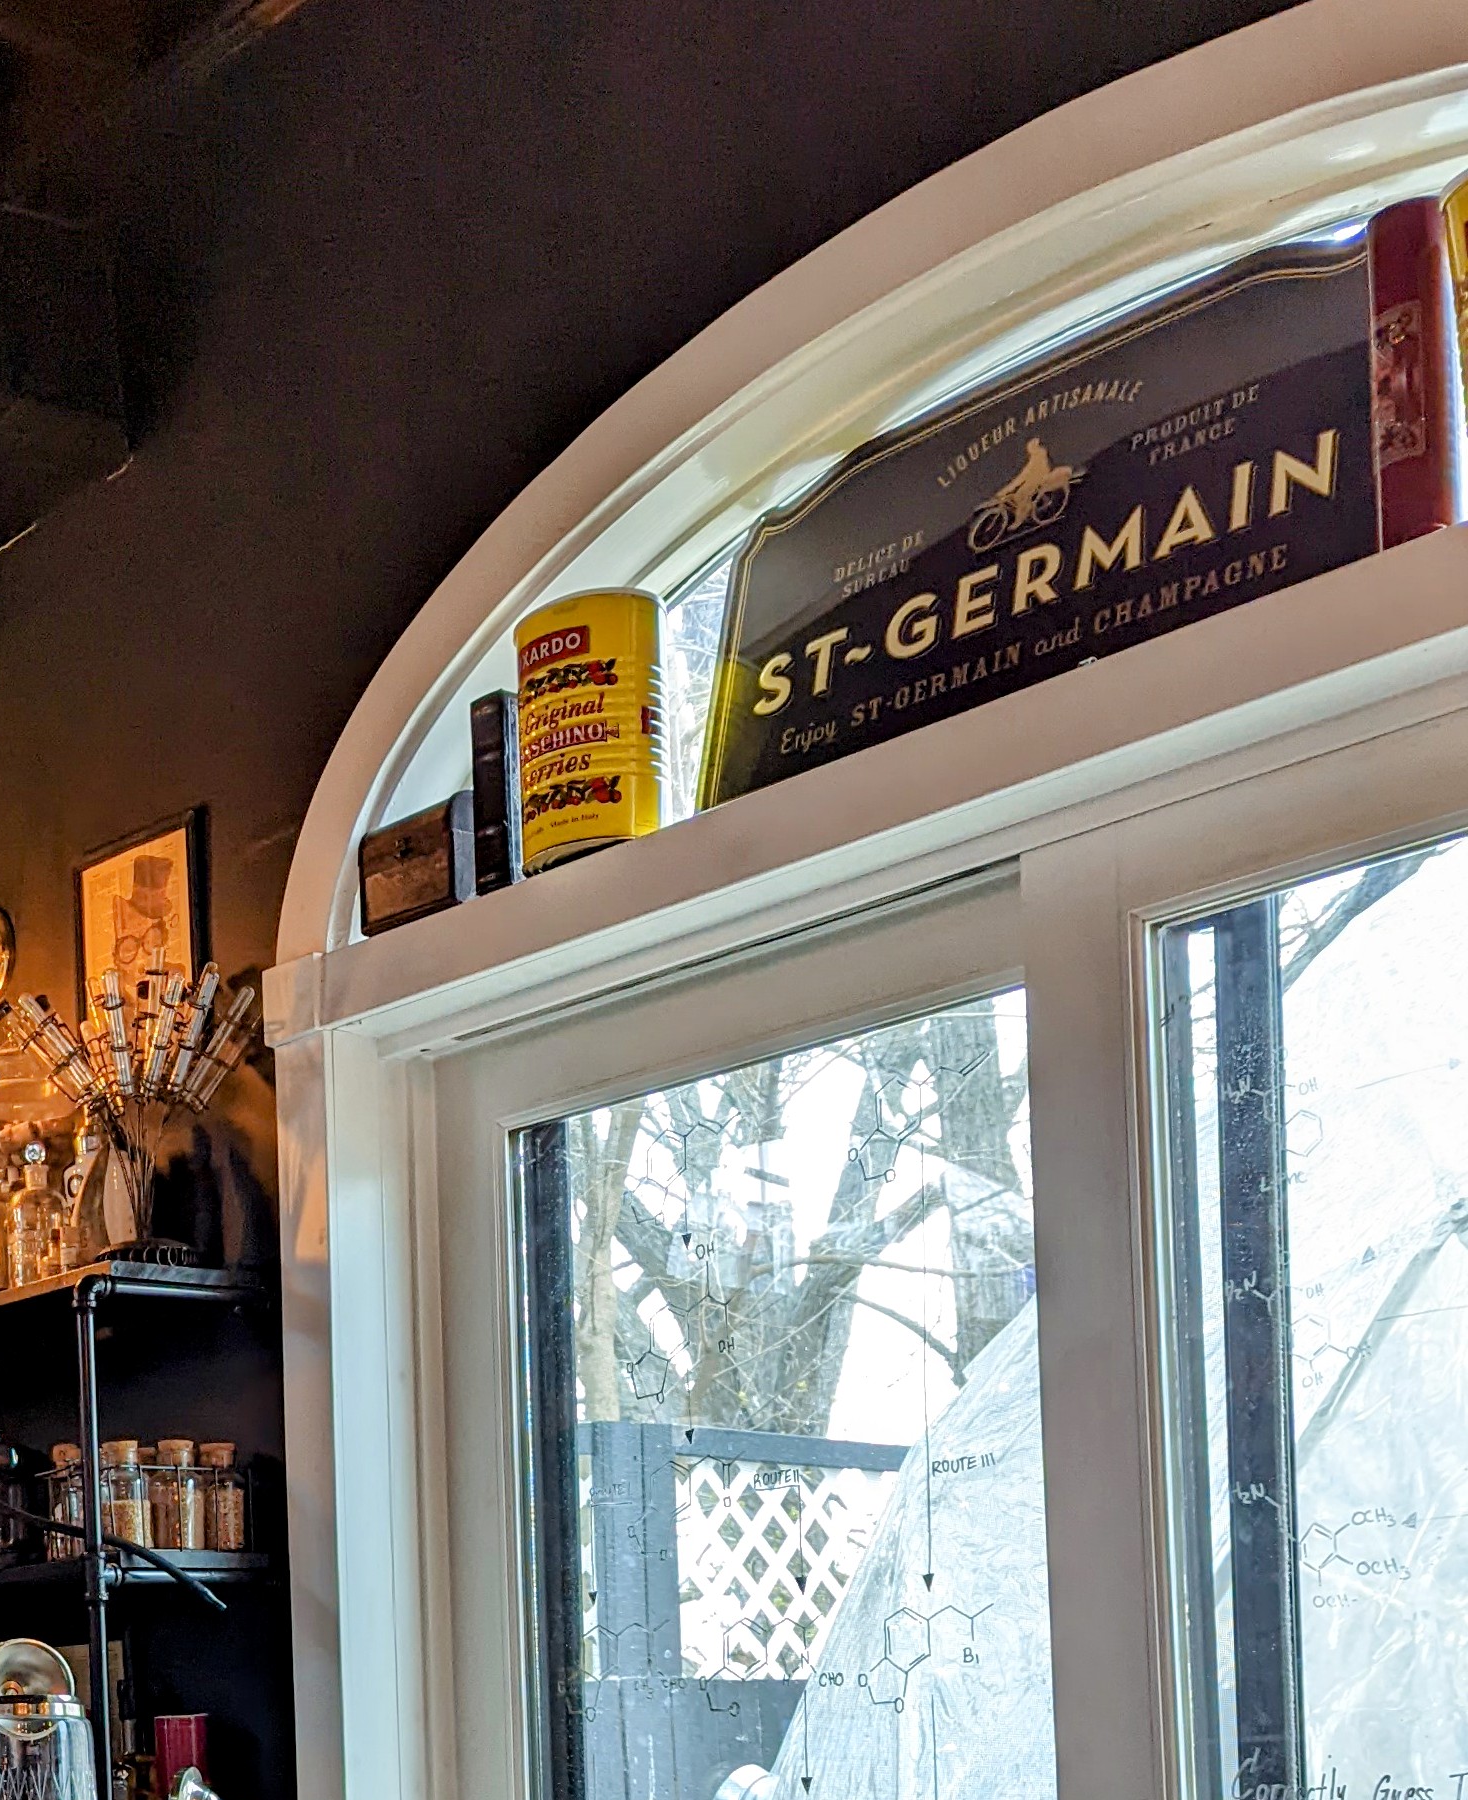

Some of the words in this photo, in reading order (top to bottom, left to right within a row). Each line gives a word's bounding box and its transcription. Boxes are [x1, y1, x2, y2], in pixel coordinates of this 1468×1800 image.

[937, 417, 1017, 488] LIQUEUR
[1024, 379, 1145, 426] ARTISANALE
[1131, 397, 1226, 452] PRODUIT
[1231, 383, 1261, 409] DE
[1149, 418, 1236, 465] FRANCE
[901, 531, 926, 559] DE
[841, 558, 912, 599] SUREAU
[780, 714, 838, 755] Enjoy
[850, 641, 1022, 728] ST-GERMAIN
[1034, 617, 1083, 657] and
[1093, 543, 1289, 637] CHAMPAGNE
[695, 1242, 715, 1260] OH
[932, 1456, 977, 1477] ROUTE
